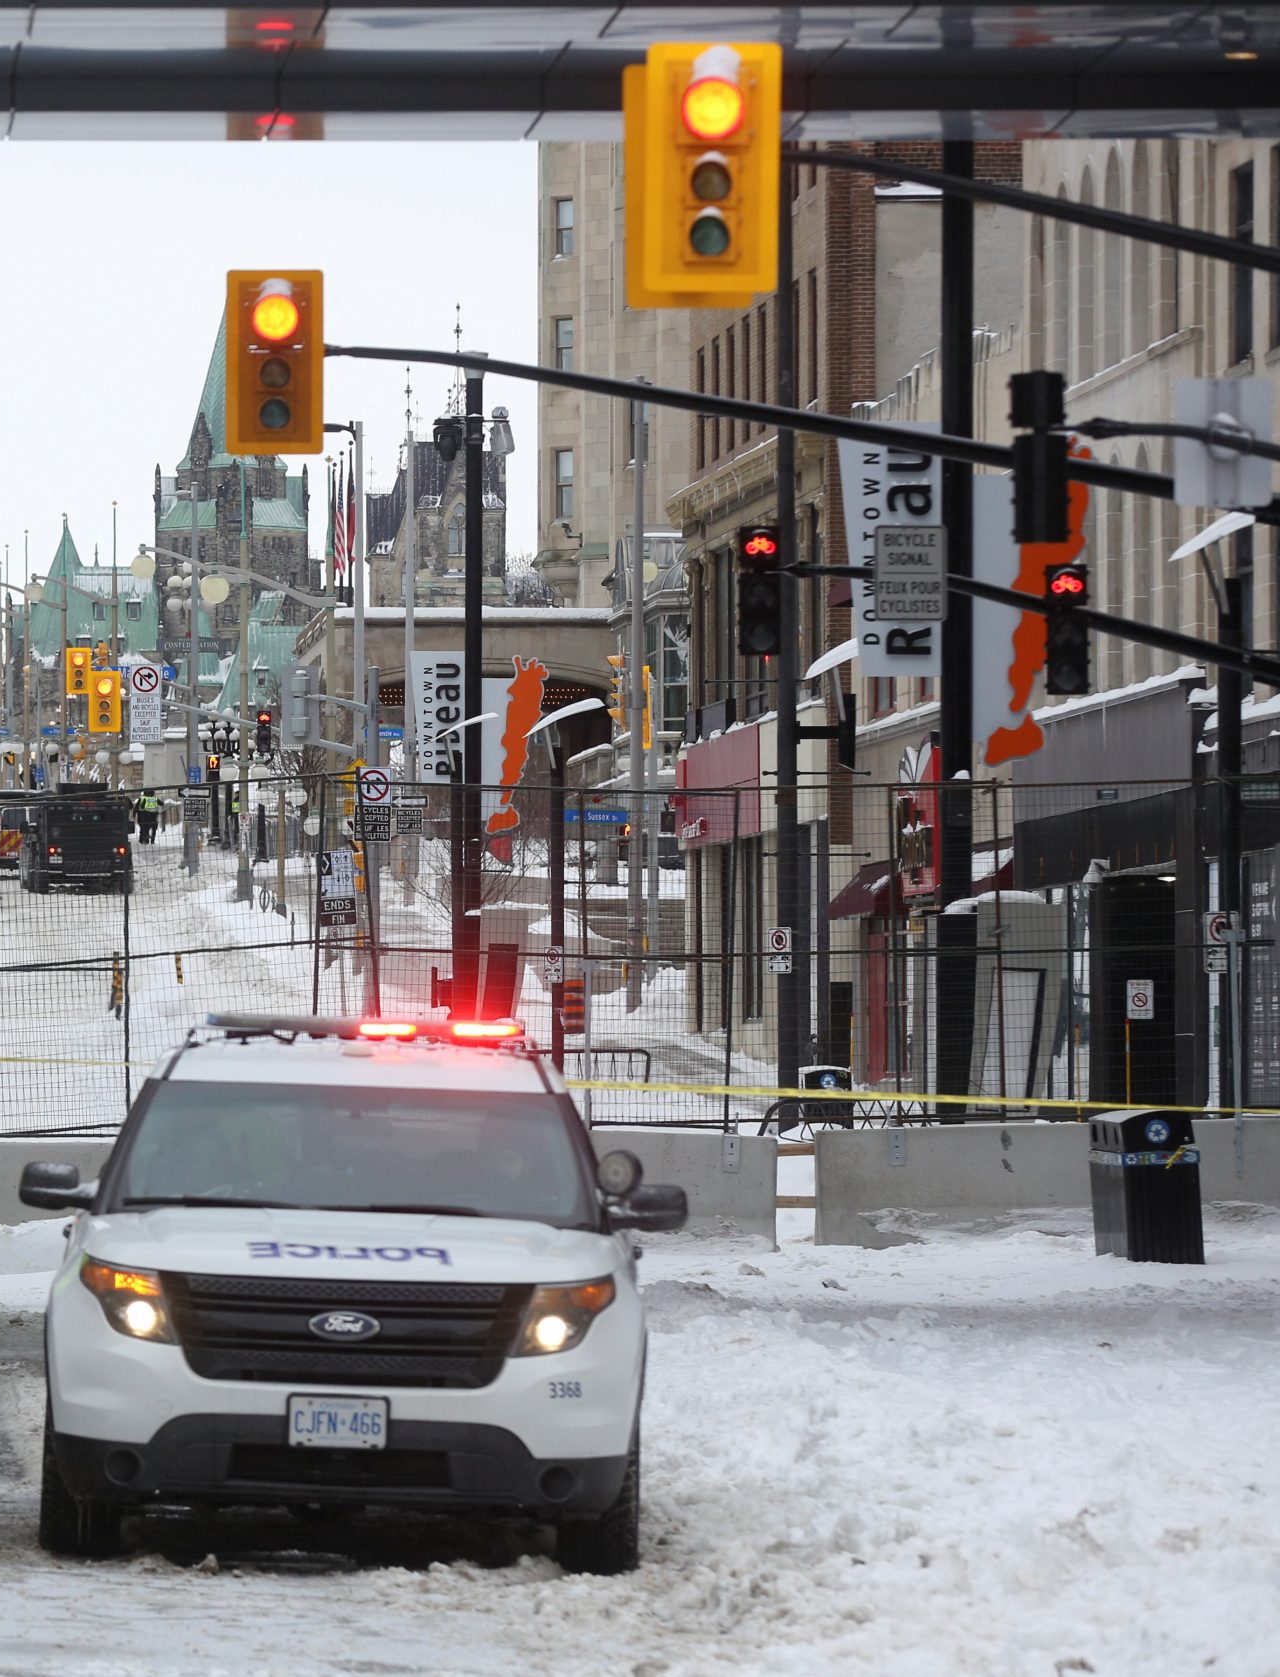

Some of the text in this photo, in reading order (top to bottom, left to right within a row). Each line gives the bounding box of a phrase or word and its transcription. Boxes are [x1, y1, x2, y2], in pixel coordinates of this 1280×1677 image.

[883, 533, 936, 547] BICYCLE
[887, 552, 933, 566] SIGNAL
[879, 581, 941, 595] FEUX POUR
[880, 600, 940, 613] CYCLISTES
[423, 667, 433, 770] DOWNTOWN
[587, 812, 610, 821] Sussex
[324, 900, 351, 911] ENDS
[332, 914, 345, 924] FIN
[324, 1315, 364, 1333] Ford
[548, 1381, 582, 1399] 3368
[294, 1410, 382, 1436] CJFN 466
